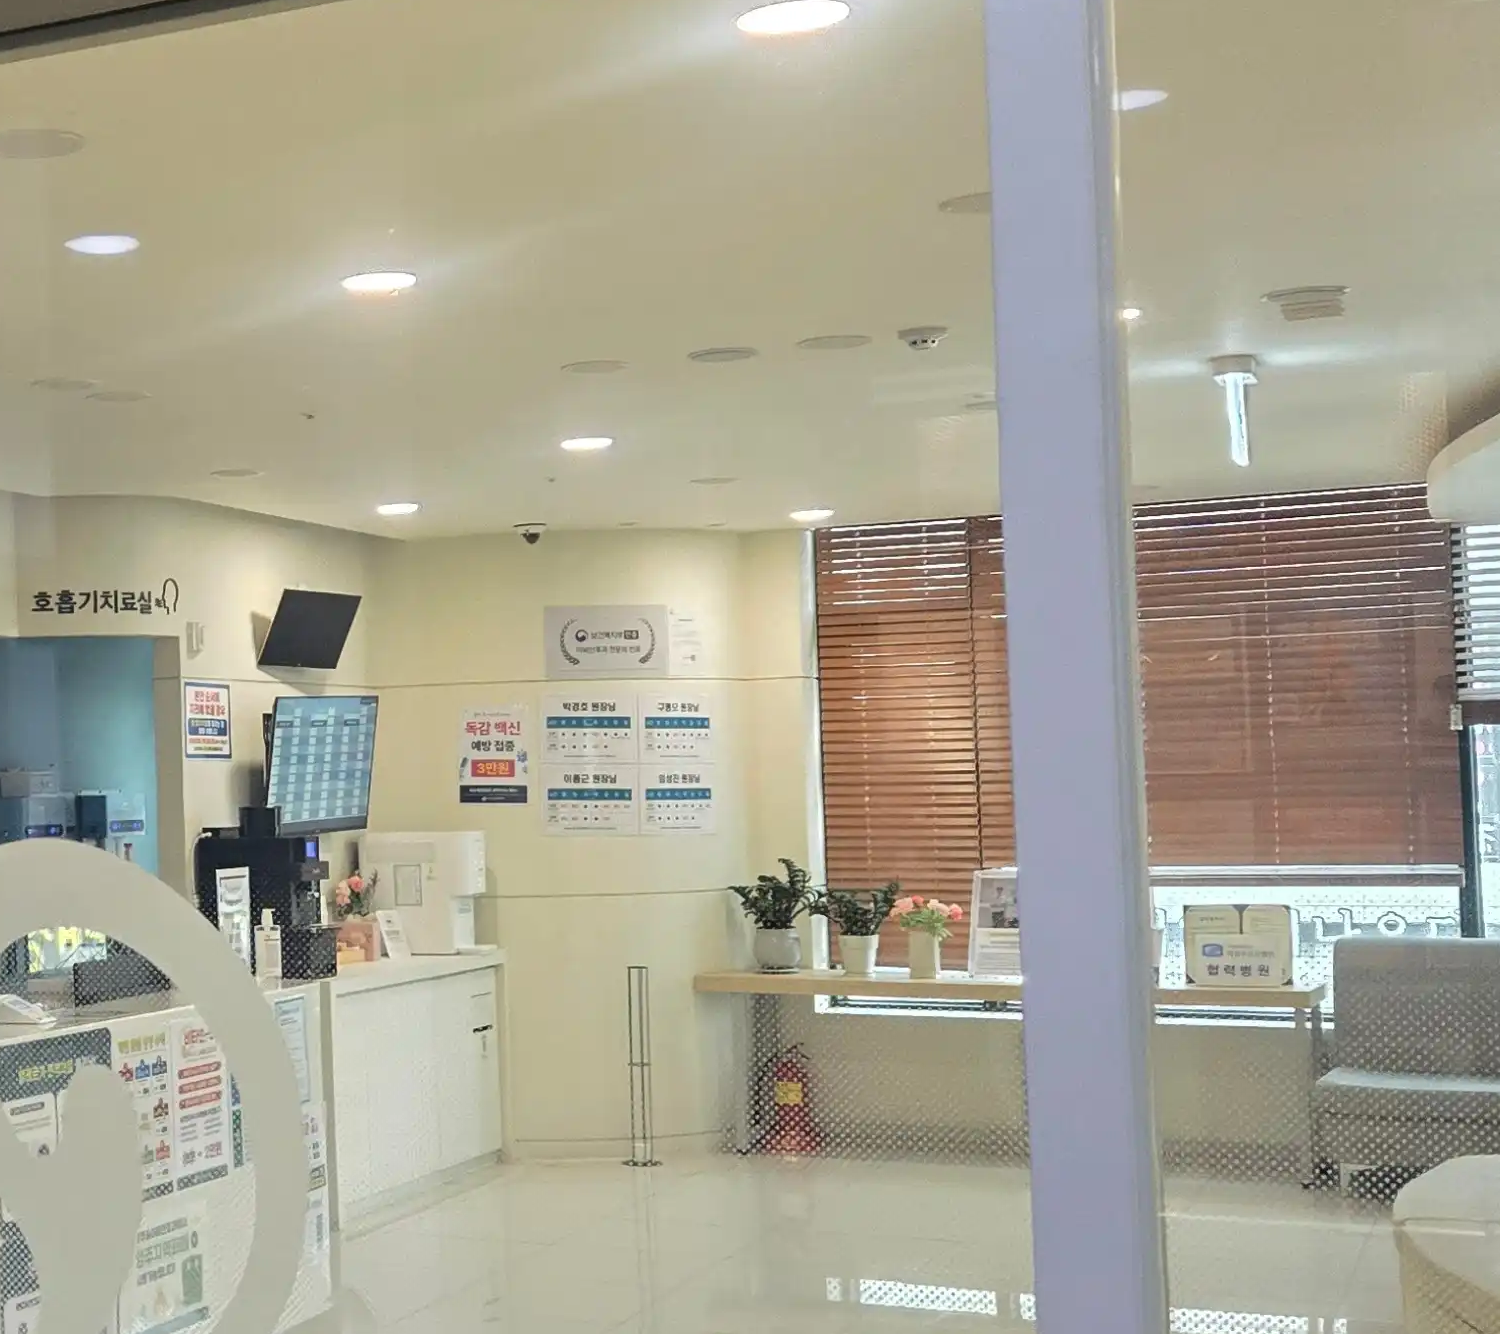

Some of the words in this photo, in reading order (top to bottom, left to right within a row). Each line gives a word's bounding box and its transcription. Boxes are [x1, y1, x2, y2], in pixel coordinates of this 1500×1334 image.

[32, 589, 153, 614] 호흡기치료실
[465, 721, 491, 736] 독감
[494, 721, 521, 736] 백신
[471, 740, 492, 752] 예방
[494, 740, 515, 752] 접종
[476, 761, 510, 775] 3만원
